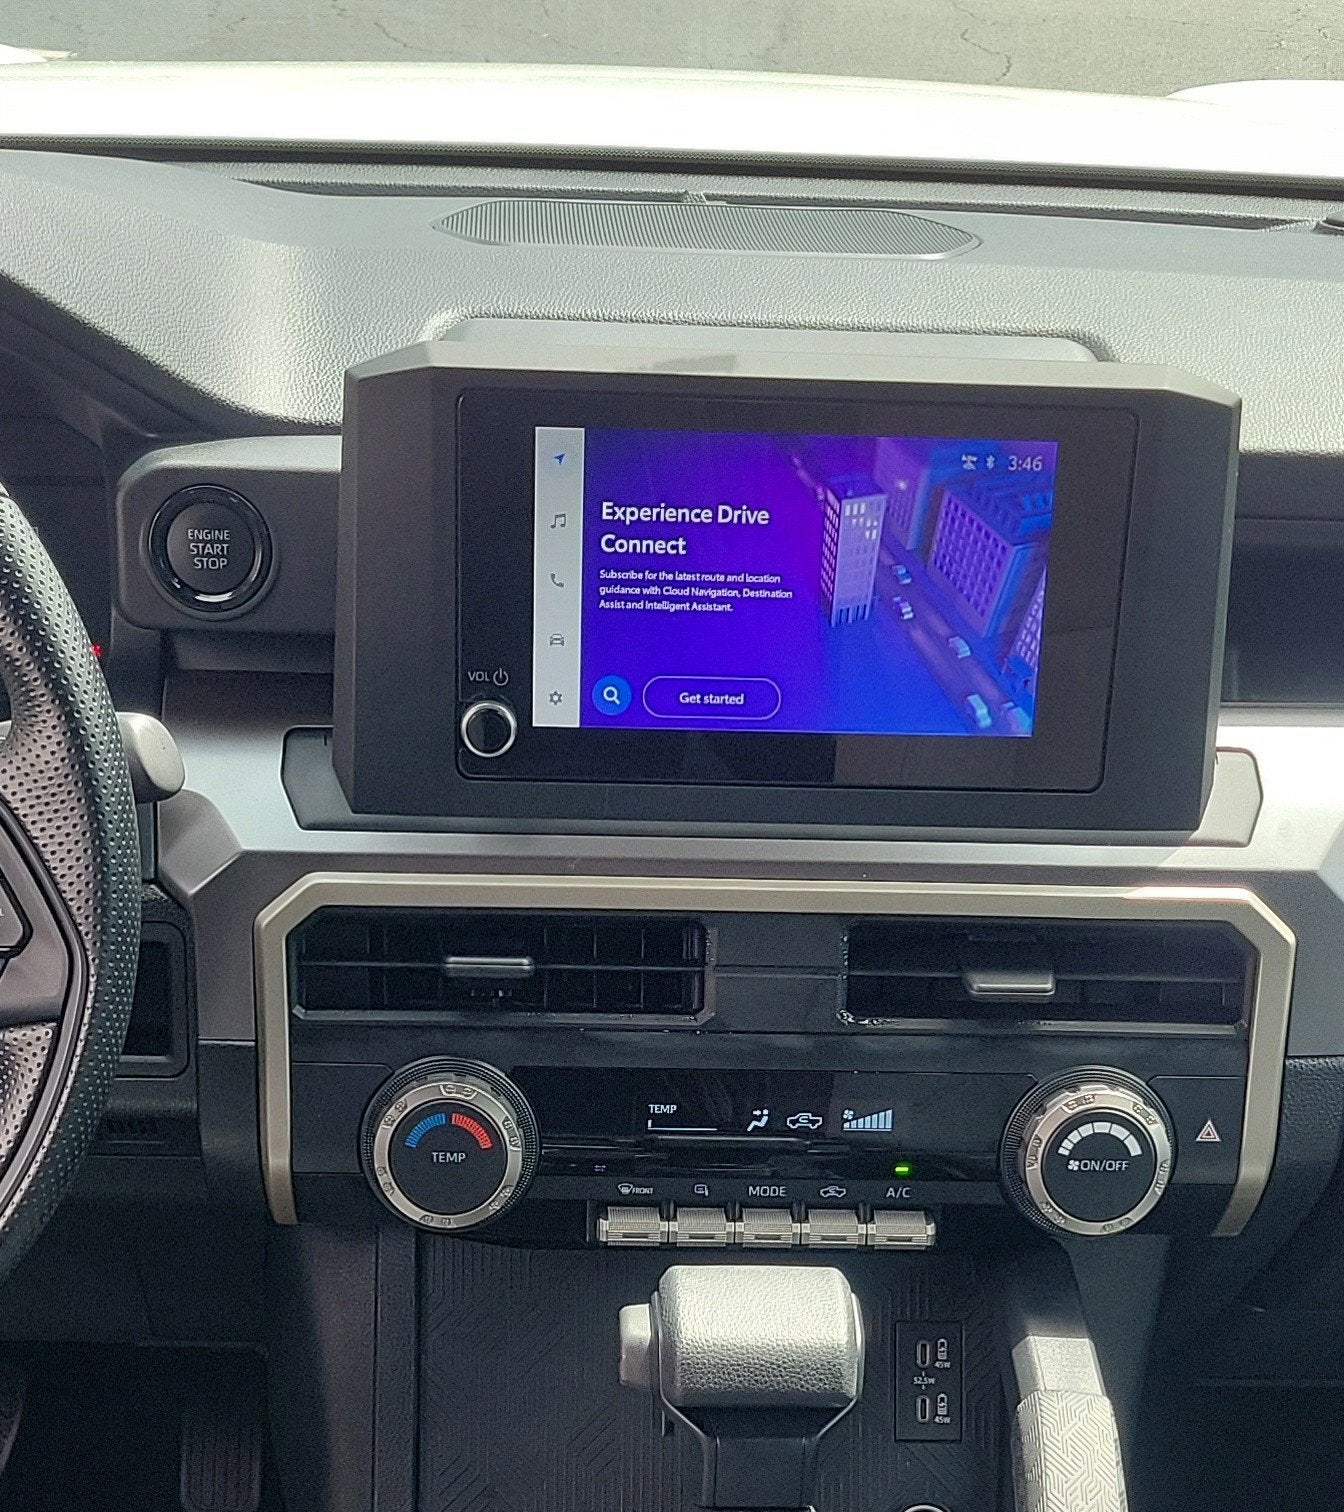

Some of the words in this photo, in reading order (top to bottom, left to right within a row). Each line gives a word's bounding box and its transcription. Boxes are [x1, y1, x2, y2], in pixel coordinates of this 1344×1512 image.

[1008, 455, 1043, 472] 3:46
[601, 501, 713, 526] Experience
[717, 504, 771, 525] Drive
[187, 529, 231, 541] ENGINE
[189, 543, 229, 555] START
[600, 533, 687, 555] Connect
[193, 558, 228, 570] STOP
[599, 569, 643, 580] Subscribe
[645, 569, 657, 580] for
[659, 570, 673, 581] the
[675, 571, 700, 581] latest
[701, 573, 725, 582] route
[726, 572, 744, 582] and
[745, 573, 781, 583] location
[599, 585, 641, 596] guidance
[642, 585, 661, 595] with
[662, 586, 690, 596] Cloud
[743, 588, 793, 598] Destination
[599, 599, 626, 609] Assist
[626, 600, 643, 610] and
[645, 601, 690, 612] Intelligent
[467, 671, 491, 682] VOL
[679, 692, 701, 706] Get
[704, 693, 745, 705] started
[648, 1104, 677, 1114] TEMP
[431, 1152, 467, 1163] TEMP
[1080, 1159, 1130, 1172] ON/OFF
[632, 1186, 654, 1195] FRONT
[748, 1186, 787, 1197] MODE
[886, 1186, 911, 1198] A/C
